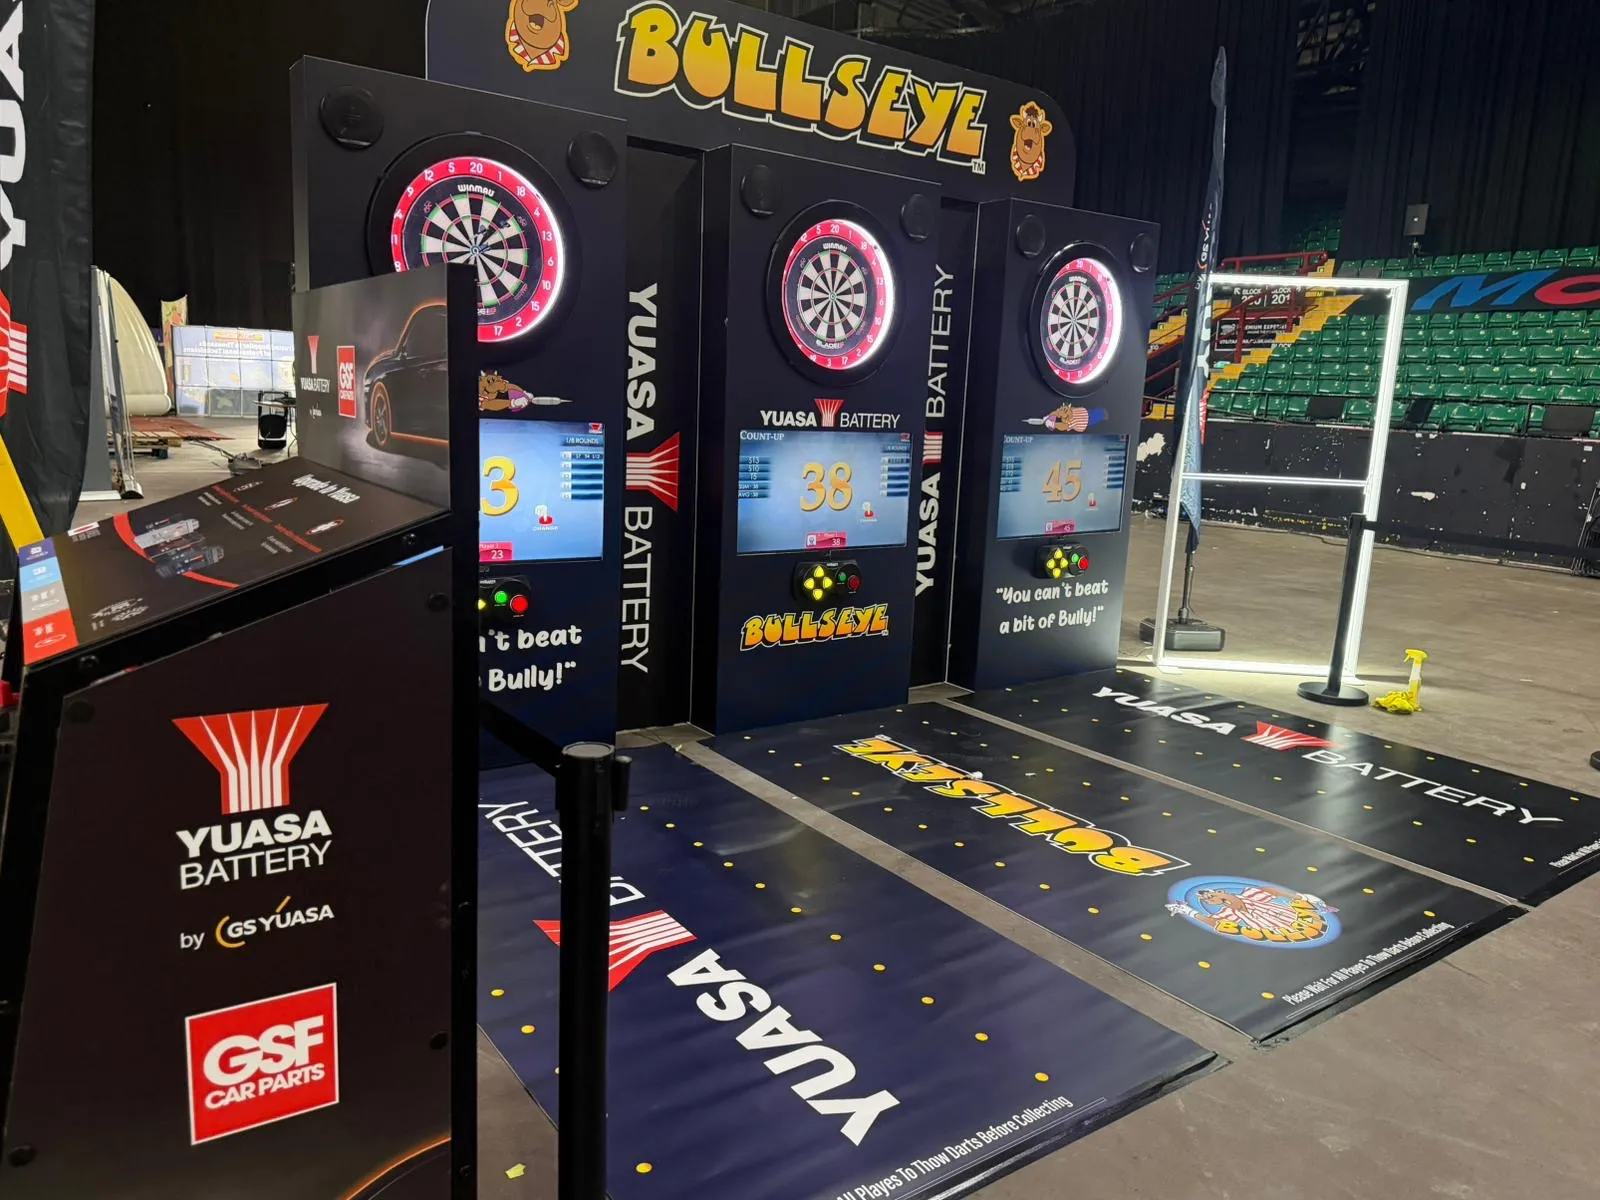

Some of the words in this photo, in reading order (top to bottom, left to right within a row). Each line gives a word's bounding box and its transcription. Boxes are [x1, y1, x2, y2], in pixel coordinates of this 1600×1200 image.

[615, 0, 987, 166] BULLSEYE
[424, 170, 434, 182] 12
[449, 162, 455, 173] 5
[470, 163, 483, 173] 20
[497, 172, 502, 181] 1
[407, 187, 415, 197] 9
[457, 184, 495, 197] WINMAU
[516, 185, 526, 196] 18
[534, 208, 540, 217] 4
[542, 231, 553, 241] 13
[816, 225, 822, 235] 5
[830, 224, 840, 234] 20
[547, 259, 554, 267] 6
[542, 281, 551, 290] 10
[531, 301, 540, 311] 15
[494, 326, 503, 336] 17
[516, 317, 522, 327] 2
[925, 264, 954, 418] BATTERY
[626, 282, 658, 441] YUASA
[760, 410, 818, 427] YUASA
[840, 413, 900, 428] BATTERY
[740, 430, 785, 441] COUNT-UP
[800, 461, 853, 512] 38
[1041, 459, 1084, 503] 45
[832, 538, 841, 546] 38
[914, 472, 942, 597] YUASA
[491, 550, 504, 560] 23
[621, 506, 653, 674] BATTERY
[1034, 582, 1073, 601] can't
[1074, 580, 1110, 597] beat
[740, 603, 889, 651] BULLSEYE
[999, 621, 1010, 634] a
[1013, 615, 1035, 633] bit
[1038, 613, 1056, 629] of
[517, 625, 582, 650] beat
[1092, 686, 1237, 736] YUASA
[1302, 750, 1564, 824] BATTERY
[833, 735, 1191, 875] BULLSEYE
[176, 810, 333, 858] YUASA
[180, 840, 332, 890] BATTERY
[180, 932, 205, 950] by
[1281, 988, 1315, 1005] Please
[1303, 980, 1331, 994] Wait
[1319, 976, 1341, 987] For
[203, 1015, 324, 1086] GSF
[667, 948, 900, 1147] YUASA
[205, 1082, 256, 1110] CAR
[259, 1063, 325, 1096] PARTS
[854, 1175, 904, 1200] Playes
[895, 1167, 918, 1182] To
[909, 1151, 951, 1175] Thow
[943, 1139, 984, 1160] Darts
[975, 1125, 1020, 1144] Before
[1012, 1095, 1074, 1126] Collecting
